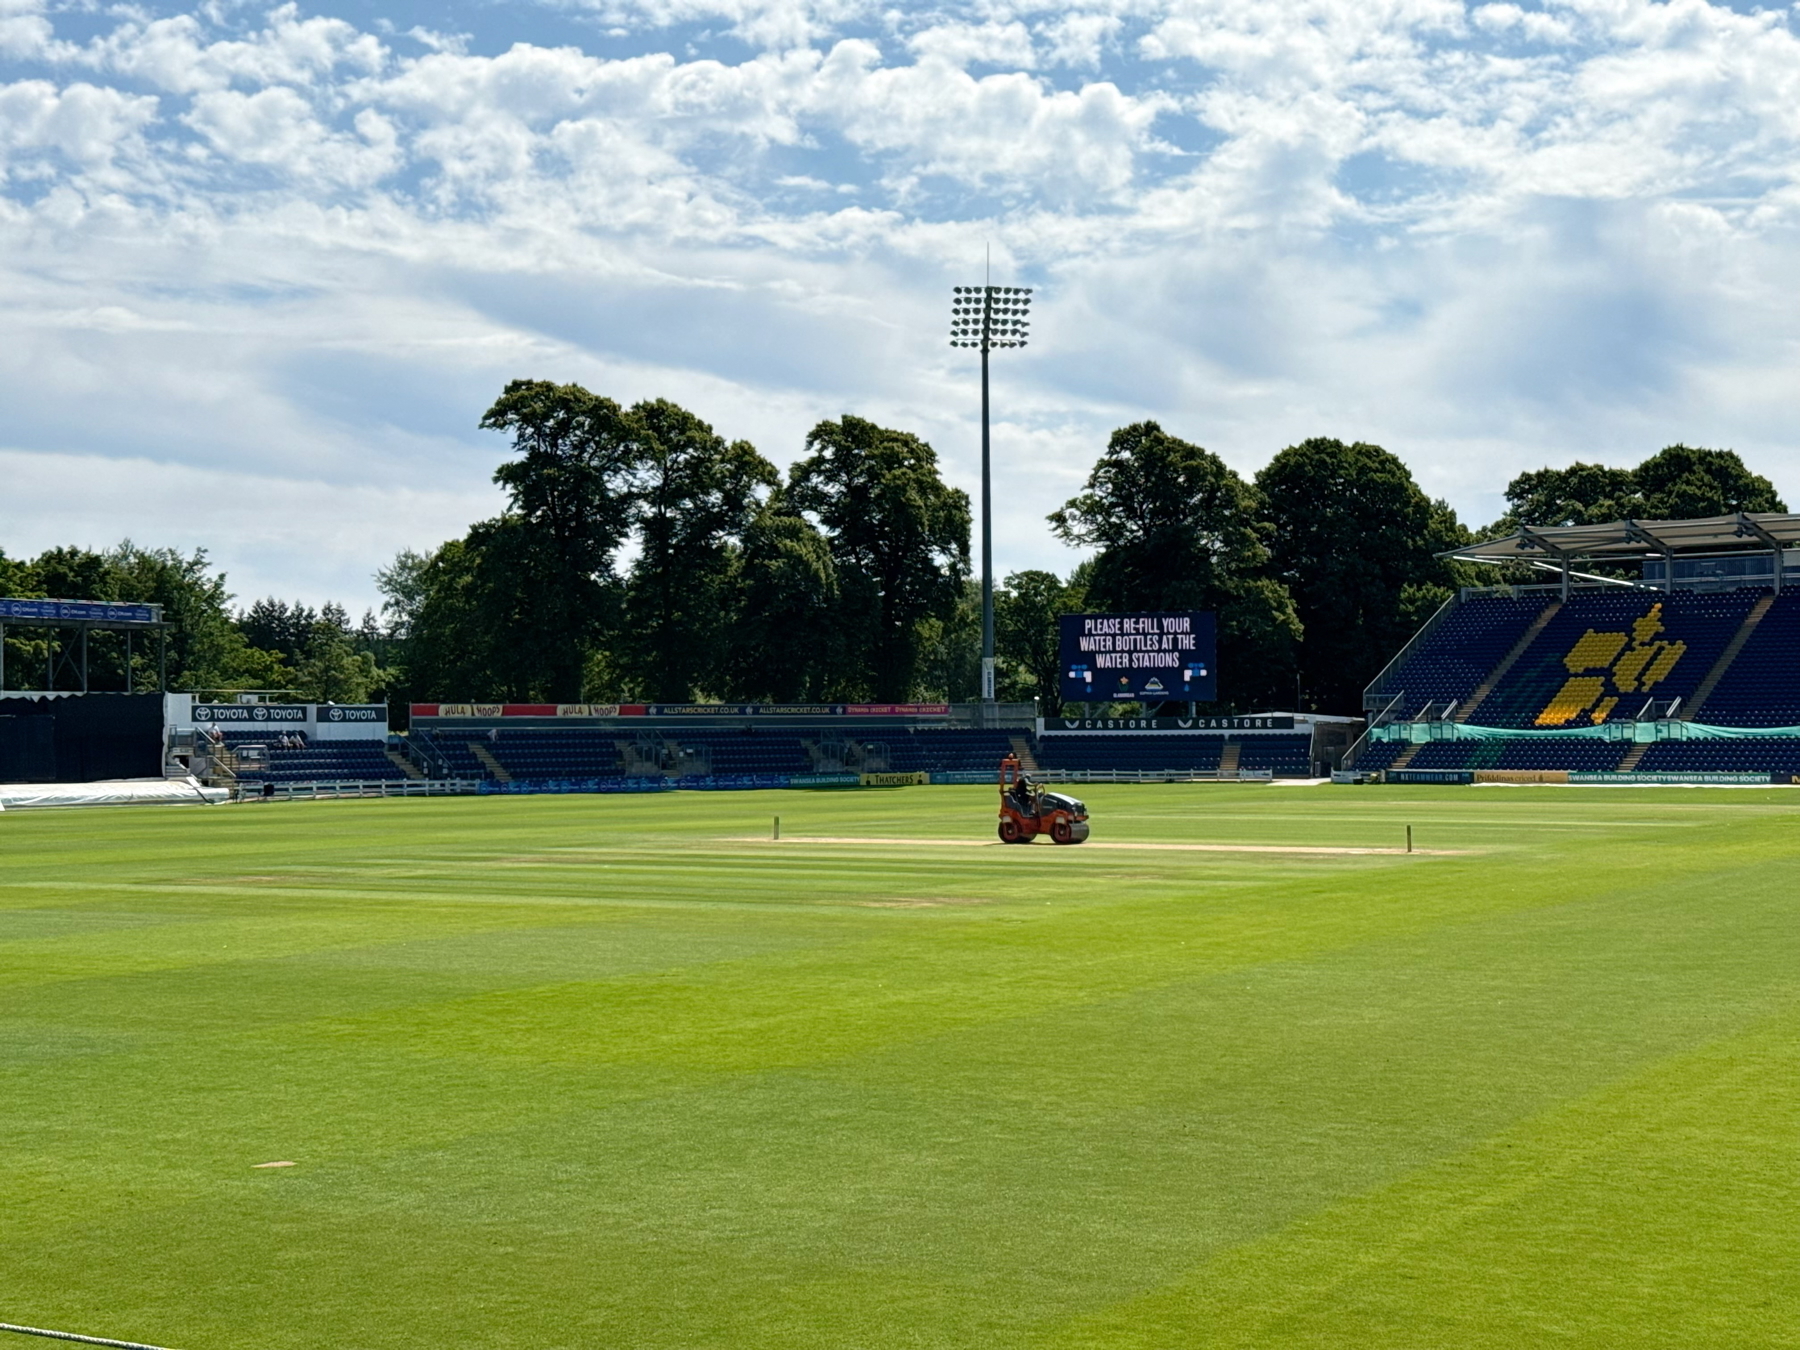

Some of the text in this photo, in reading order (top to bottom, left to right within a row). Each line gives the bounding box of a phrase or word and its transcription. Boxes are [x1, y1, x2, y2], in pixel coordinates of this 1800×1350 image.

[1084, 617, 1190, 635] PLEASE RE-FILL YOUR
[1079, 634, 1196, 652] WATER BOTTLES AT THE
[1096, 652, 1180, 669] WATER STATIONS
[213, 708, 249, 720] TOYOTA
[269, 709, 304, 720] TOYOTA
[345, 709, 377, 720] TOYOTA
[444, 705, 501, 717] HULA HOOPS
[562, 705, 617, 717] HULA HOOPS
[663, 706, 740, 715] ALLSTARSCRICKET.CO.UK
[759, 706, 830, 714] ALLSTARSCRICKET.CO.UK
[1085, 719, 1158, 729] CASTORE
[1199, 718, 1273, 728] CASTORE
[875, 775, 914, 785] THATCHERS
[1567, 774, 1667, 782] SWANSEA BUILDING SOCIETY
[1667, 775, 1771, 783] SWANSEA BUILDING SOCIETY
